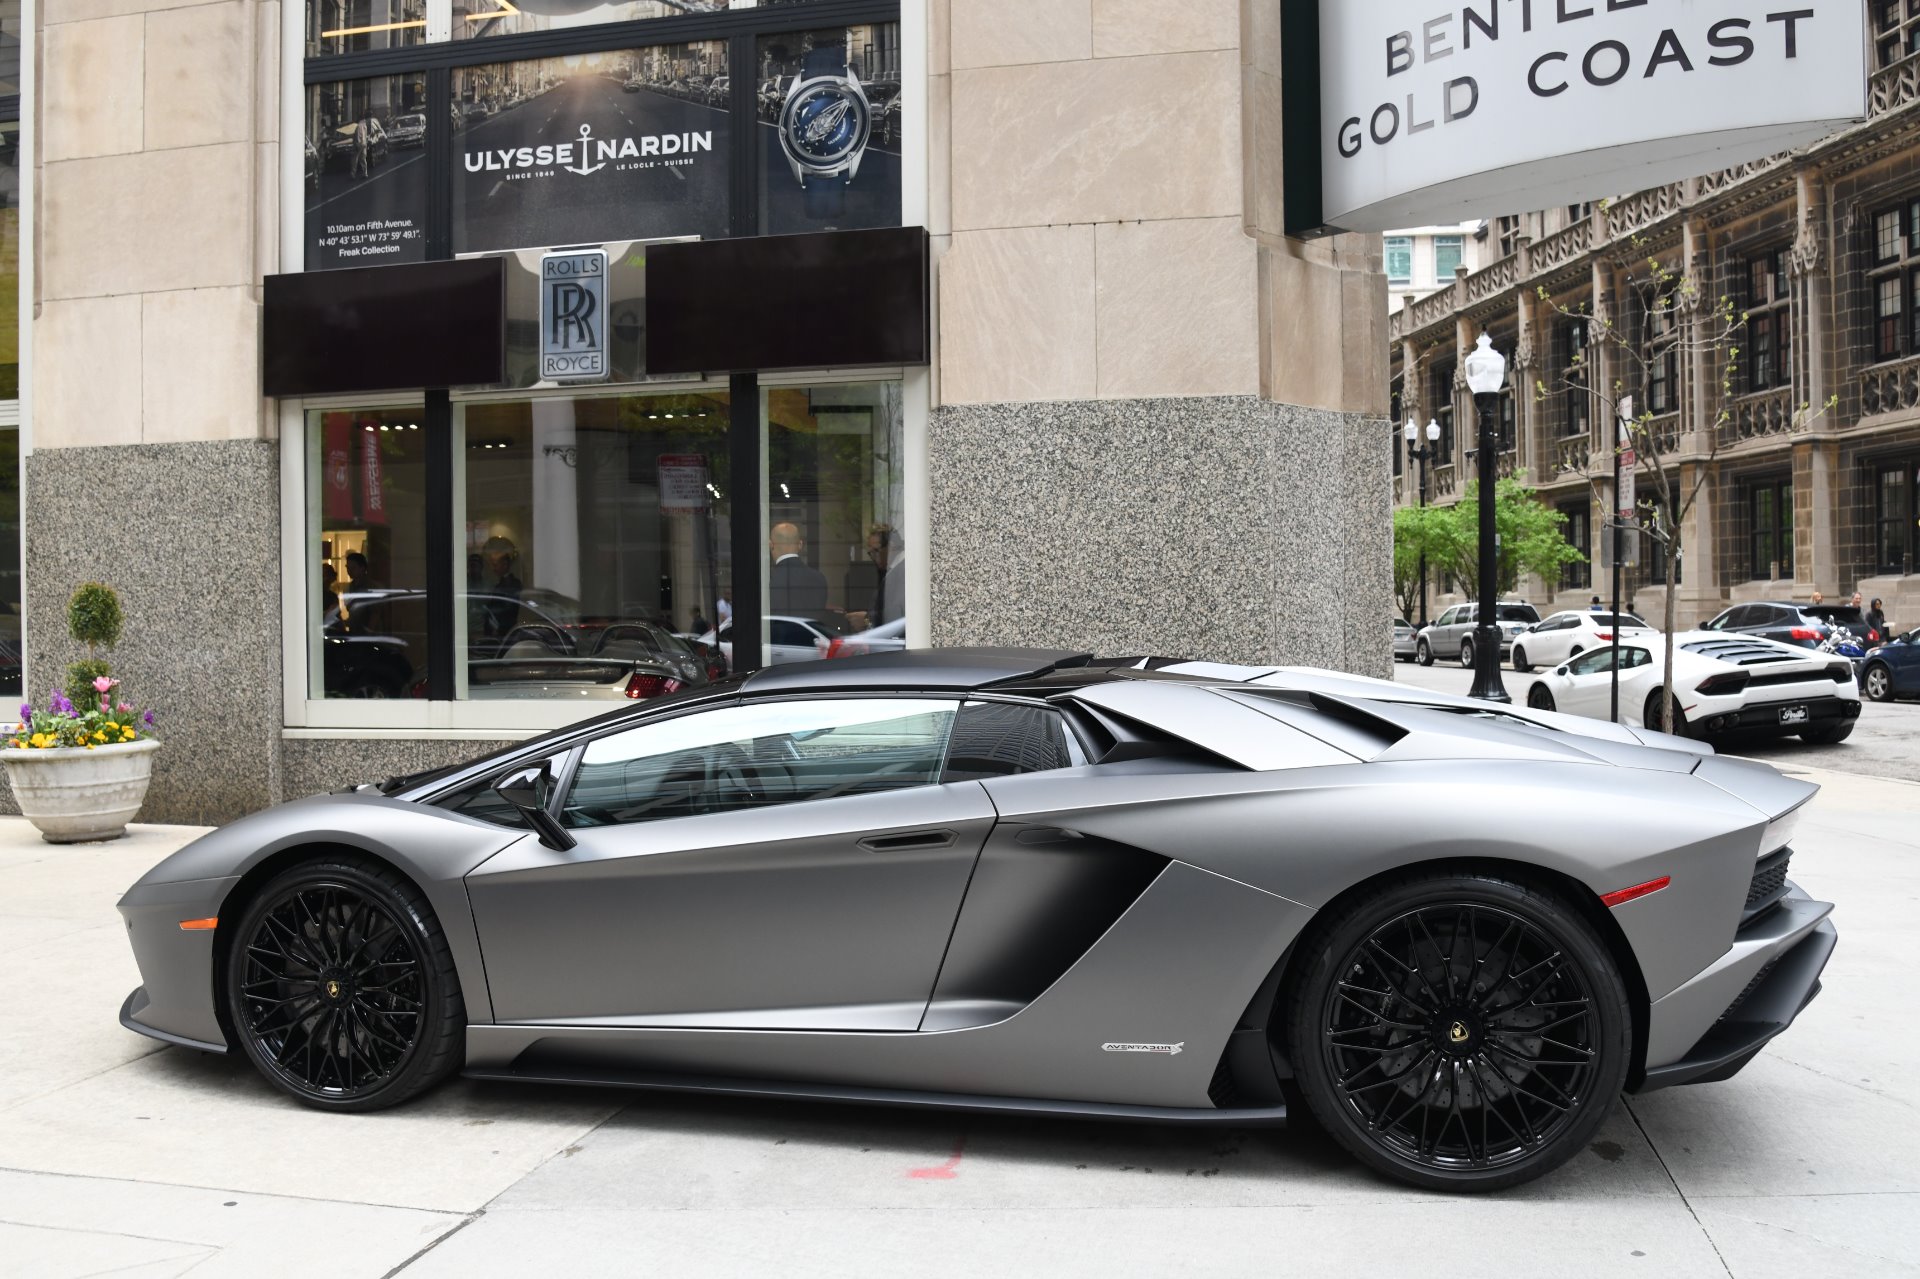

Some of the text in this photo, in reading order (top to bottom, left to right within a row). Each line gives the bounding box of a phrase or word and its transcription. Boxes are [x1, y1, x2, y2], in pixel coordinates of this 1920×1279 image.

[1386, 0, 1648, 78] BENTL
[1337, 8, 1814, 159] GOLD COAST
[464, 130, 712, 172] ULYSSE NARDIN
[628, 161, 655, 169] LOCLE
[664, 158, 694, 167] SUISSE
[506, 172, 532, 181] SINCE
[327, 225, 355, 234] 10.10am
[366, 220, 383, 230] Fifth
[384, 219, 413, 229] Avenue.
[319, 238, 325, 247] N
[368, 234, 377, 243] W
[338, 244, 400, 257] Freak Collection
[547, 258, 599, 276] ROLLS
[547, 355, 599, 372] ROYCE
[1106, 1043, 1171, 1051] AVENTADOR
